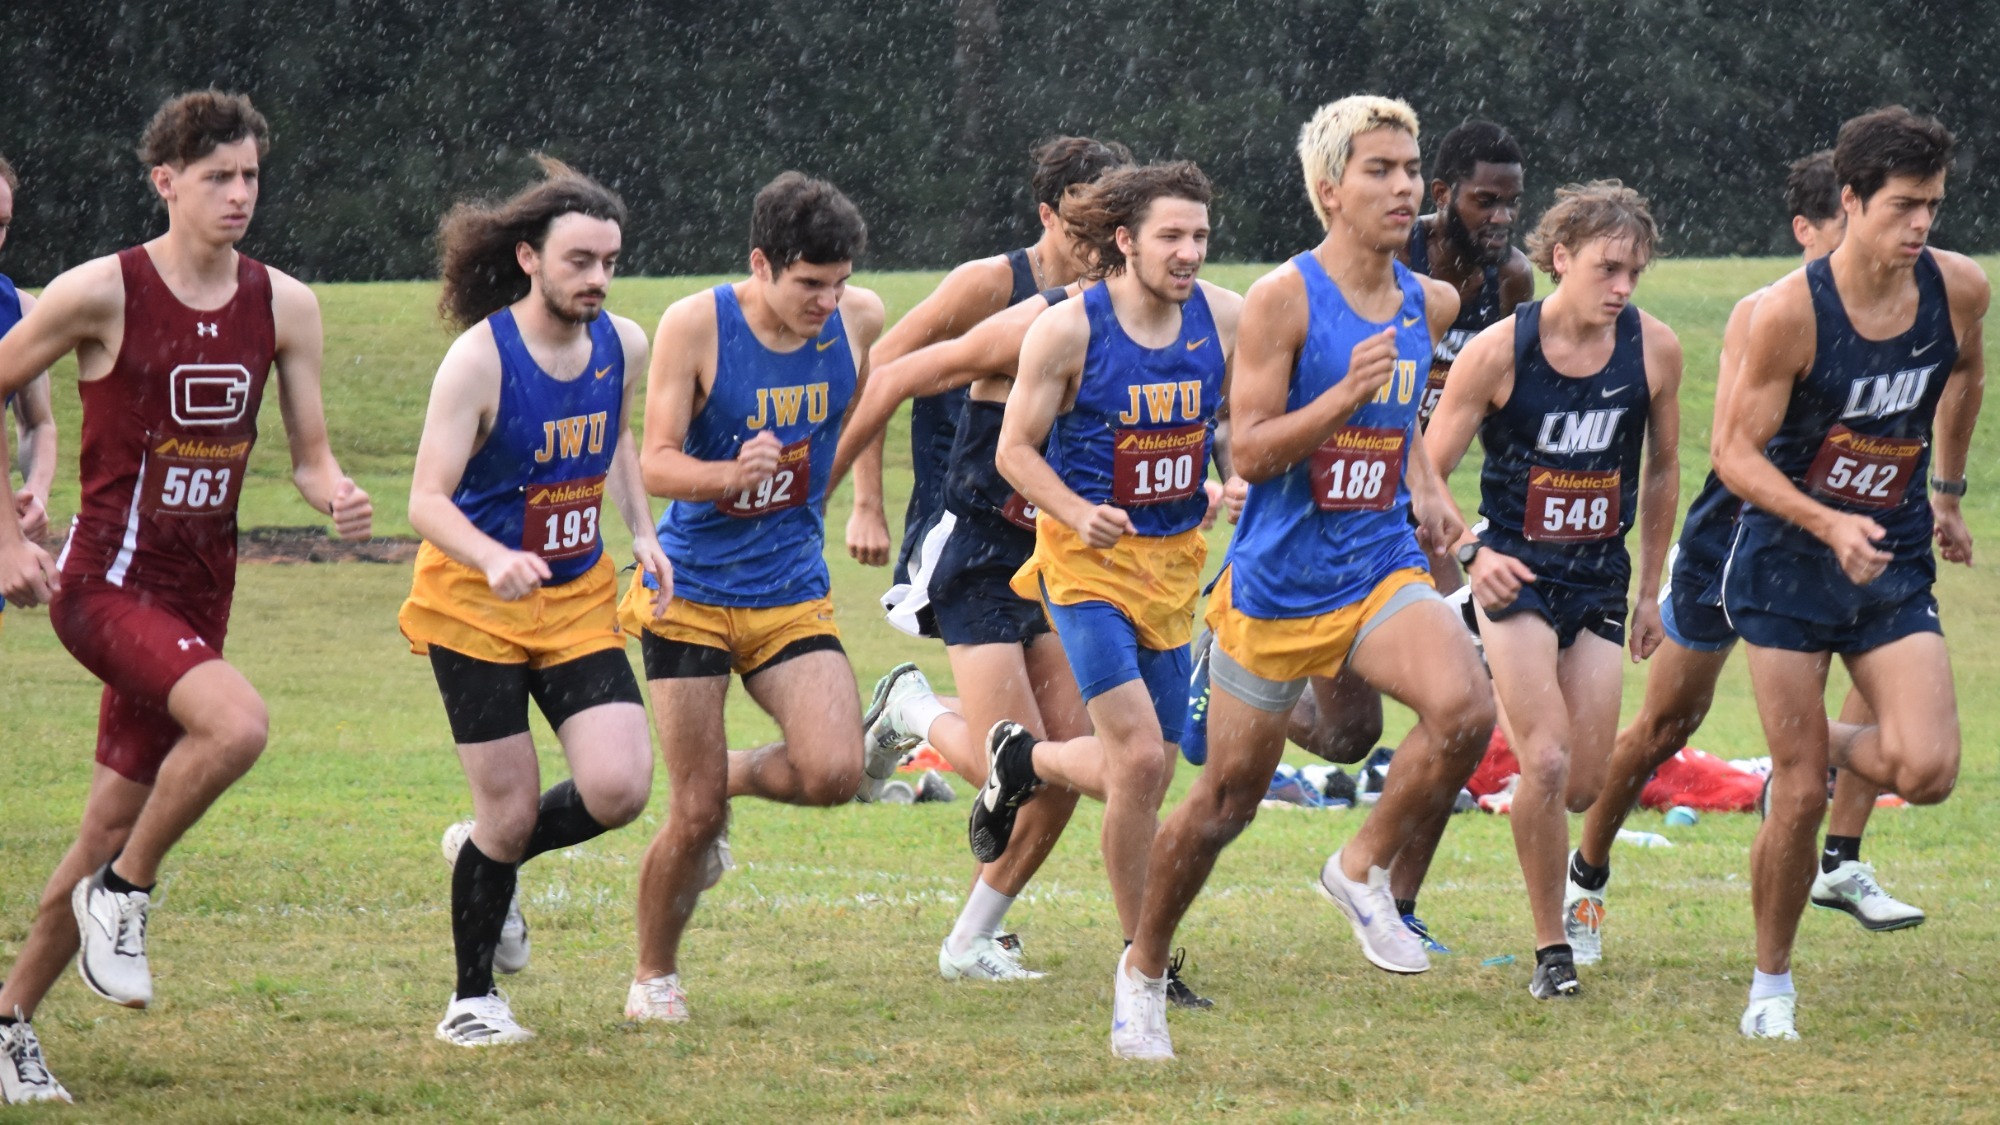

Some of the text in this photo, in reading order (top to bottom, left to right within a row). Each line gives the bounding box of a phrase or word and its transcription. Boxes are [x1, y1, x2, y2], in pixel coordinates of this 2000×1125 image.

[747, 382, 829, 430] JWU
[1119, 380, 1202, 425] JWU
[1839, 361, 1942, 420] LMU
[534, 411, 607, 463] JWU
[1535, 408, 1628, 457] LMU
[161, 466, 231, 507] 563
[1134, 455, 1193, 495] 190
[1327, 459, 1386, 499] 188
[1826, 456, 1898, 497] 542
[544, 506, 597, 551] 193
[1543, 497, 1609, 531] 548
